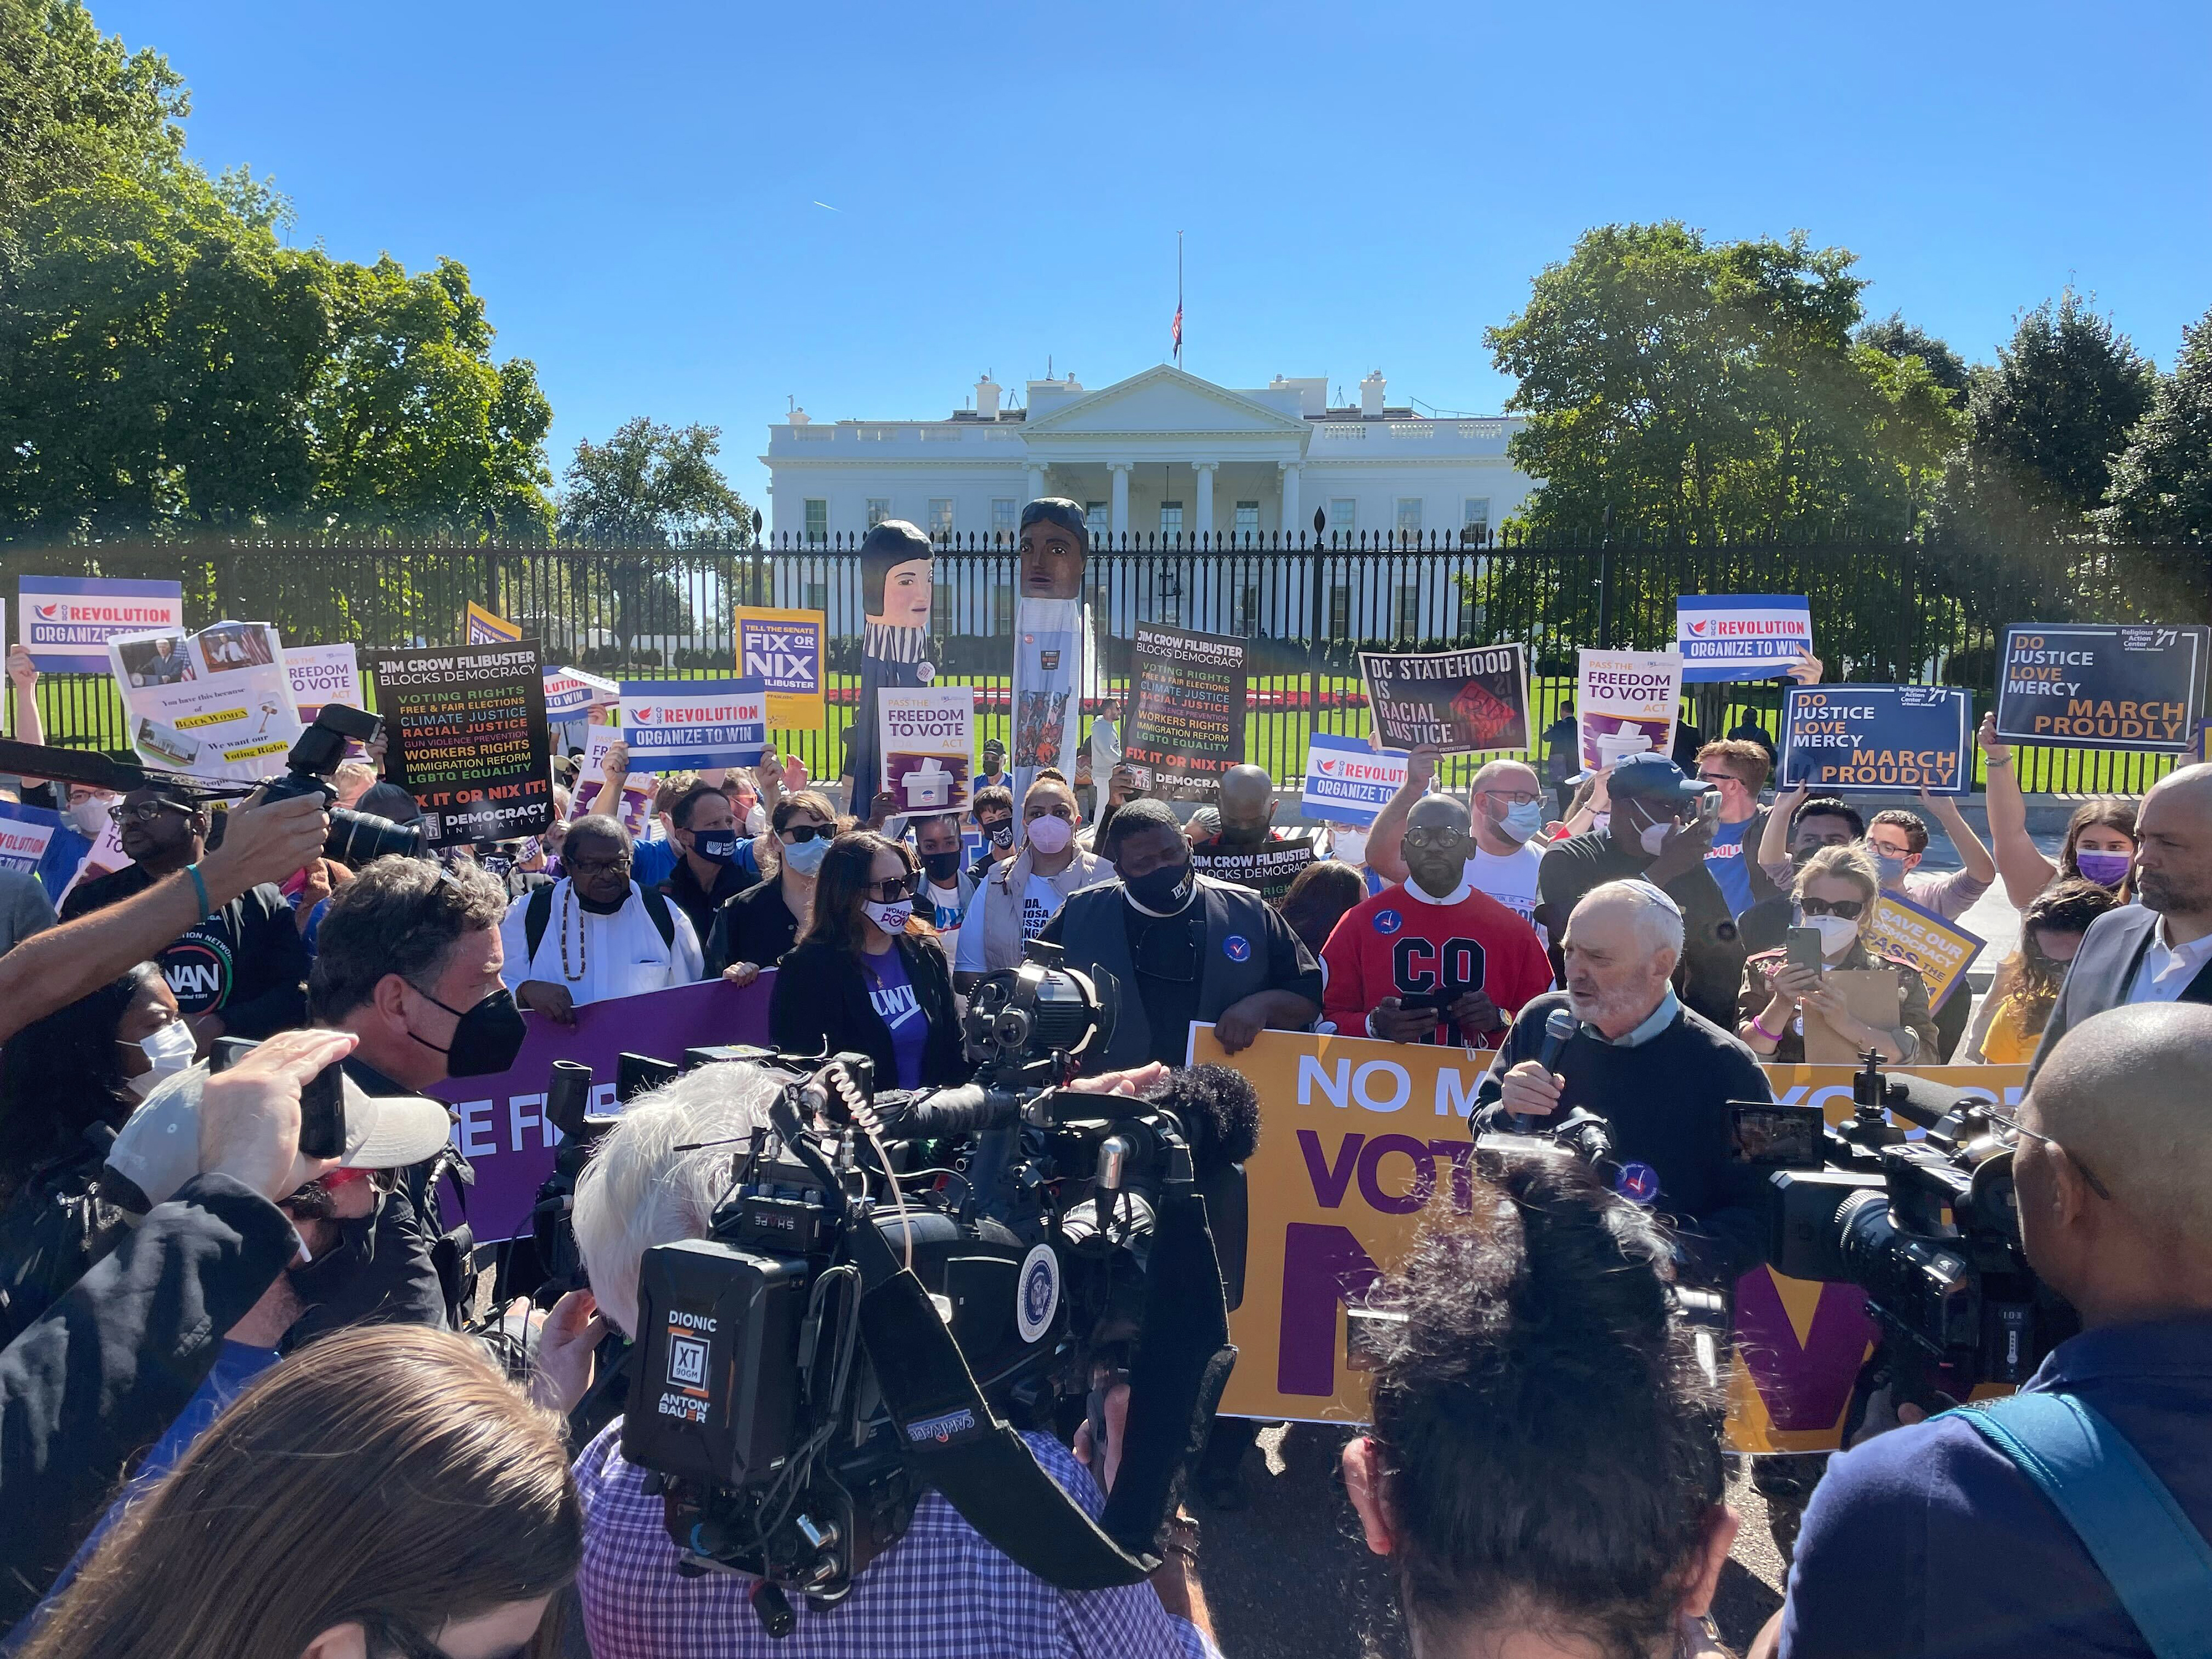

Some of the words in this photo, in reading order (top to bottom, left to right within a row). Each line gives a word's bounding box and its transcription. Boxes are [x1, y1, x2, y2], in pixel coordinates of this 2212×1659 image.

[71, 606, 170, 622] REVOLUTION
[36, 626, 111, 642] ORGANIZE
[1719, 621, 1805, 635] REVOLUTION
[745, 633, 791, 653] FIX
[794, 636, 814, 646] OR
[1137, 630, 1153, 643] JIM
[1154, 634, 1183, 649] CROW
[1185, 639, 1243, 658] FILIBUSTER
[1691, 641, 1752, 657] ORGANIZE
[1757, 641, 1773, 656] TO
[1776, 640, 1800, 656] WIN
[2015, 636, 2045, 649] DO
[379, 661, 404, 673] JIM
[407, 657, 453, 672] CROW
[457, 651, 535, 669] FILIBUSTER
[1137, 643, 1172, 657] BLOCKS
[1174, 651, 1243, 669] DEMOCRACY
[1371, 659, 1392, 678] DC
[1400, 651, 1512, 680] STATEHOOD
[2010, 651, 2094, 666] JUSTICE
[289, 664, 348, 678] REEDOM
[380, 672, 440, 686] BLOCKS
[445, 664, 536, 682] DEMOCRACY
[746, 652, 814, 680] NIX
[1142, 662, 1183, 677] VOTING
[1188, 669, 1231, 683] RIGHTS
[2010, 667, 2062, 681] LOVE
[308, 676, 350, 690] VOTE
[1142, 672, 1159, 681] FREE
[1168, 677, 1184, 686] FAIR
[1186, 680, 1230, 692] ELECTIONS
[1588, 672, 1671, 686] FREEDOM
[2007, 681, 2081, 696] MERCY
[214, 688, 246, 699] because
[398, 692, 460, 704] VOTING
[468, 686, 525, 699] RIGHTS
[546, 697, 560, 707] TO
[563, 691, 583, 705] WIN
[1140, 681, 1181, 697] CLIMATE
[1185, 689, 1230, 704] JUSTICE
[1375, 680, 1390, 699] IS
[1588, 685, 1614, 699] TO
[1618, 687, 1669, 701] VOTE
[400, 705, 426, 715] FREE
[441, 702, 465, 712] FAIR
[468, 697, 525, 709] ELECTIONS
[1140, 692, 1177, 706] RACIAL
[1182, 700, 1230, 713] JUSTICE
[1798, 694, 1827, 707] DO
[2067, 699, 2184, 721] MARCH
[175, 718, 207, 728] BLACK
[208, 710, 248, 721] WOMEN
[401, 713, 463, 727] CLIMATE
[469, 707, 527, 722] JUSTICE
[665, 705, 758, 723] REVOLUTION
[888, 709, 963, 721] FREEDOM
[1138, 710, 1186, 728] WORKERS
[1189, 719, 1229, 732] RIGHTS
[1185, 710, 1229, 722] PREVENTION
[1379, 700, 1440, 723] RACIAL
[1794, 707, 1875, 720] JUSTICE
[402, 725, 460, 737] RACIAL
[466, 718, 527, 734] JUSTICE
[636, 728, 702, 745] ORGANIZE
[705, 728, 722, 743] TO
[726, 726, 751, 742] WIN
[889, 723, 914, 737] TO
[917, 723, 963, 737] VOTE
[1137, 722, 1191, 738] IMMIGRATION
[1193, 731, 1229, 742] REFORM
[1386, 723, 1453, 744] JUSTICE
[1794, 721, 1846, 734] LOVE
[2034, 715, 2183, 739] PROUDLY
[227, 739, 250, 748] want
[428, 737, 471, 747] VIOLENCE
[474, 731, 528, 742] PREVENTION
[1136, 731, 1169, 745] LGBTQ
[1172, 738, 1229, 752] EQUALITY
[1793, 735, 1864, 747] MERCY
[224, 751, 255, 761] Voting
[257, 743, 289, 756] Rights
[404, 746, 476, 761] WORKERS
[480, 739, 530, 754] RIGHTS
[1125, 747, 1147, 761] FIX
[1150, 751, 1163, 764] IT
[1167, 755, 1186, 767] OR
[1190, 758, 1217, 771] NIX
[1852, 750, 1956, 768] MARCH
[407, 758, 484, 772] IMMIGRATION
[487, 752, 531, 766] REFORM
[408, 772, 457, 784] LGBTQ
[462, 763, 531, 779] EQUALITY
[1155, 773, 1220, 788] DEMOCRA
[1822, 766, 1954, 785] PROUDLY
[433, 792, 450, 806] IT
[456, 790, 484, 804] OR
[488, 786, 520, 800] NIX
[525, 780, 547, 794] IT!
[1317, 780, 1375, 801] ORGANIZE
[1379, 788, 1393, 802] TO
[445, 802, 547, 826] DEMOCRACY
[446, 815, 546, 834] INITIATIVE
[106, 834, 124, 853] TO
[1193, 855, 1212, 867] JIM
[1214, 855, 1253, 868] CROW
[1257, 847, 1310, 866] FILIBUSTER
[1879, 908, 1927, 938] SAVE
[1925, 933, 1964, 959] OUR
[1861, 930, 1919, 965] PASS
[868, 984, 921, 1021] LWV
[1298, 1055, 1411, 1113] NO
[755, 1216, 794, 1230] SHAPE
[669, 1310, 718, 1333] DIONIC
[677, 1346, 699, 1368] XT
[676, 1368, 698, 1379] 90GM
[658, 1403, 706, 1424] BAUER
